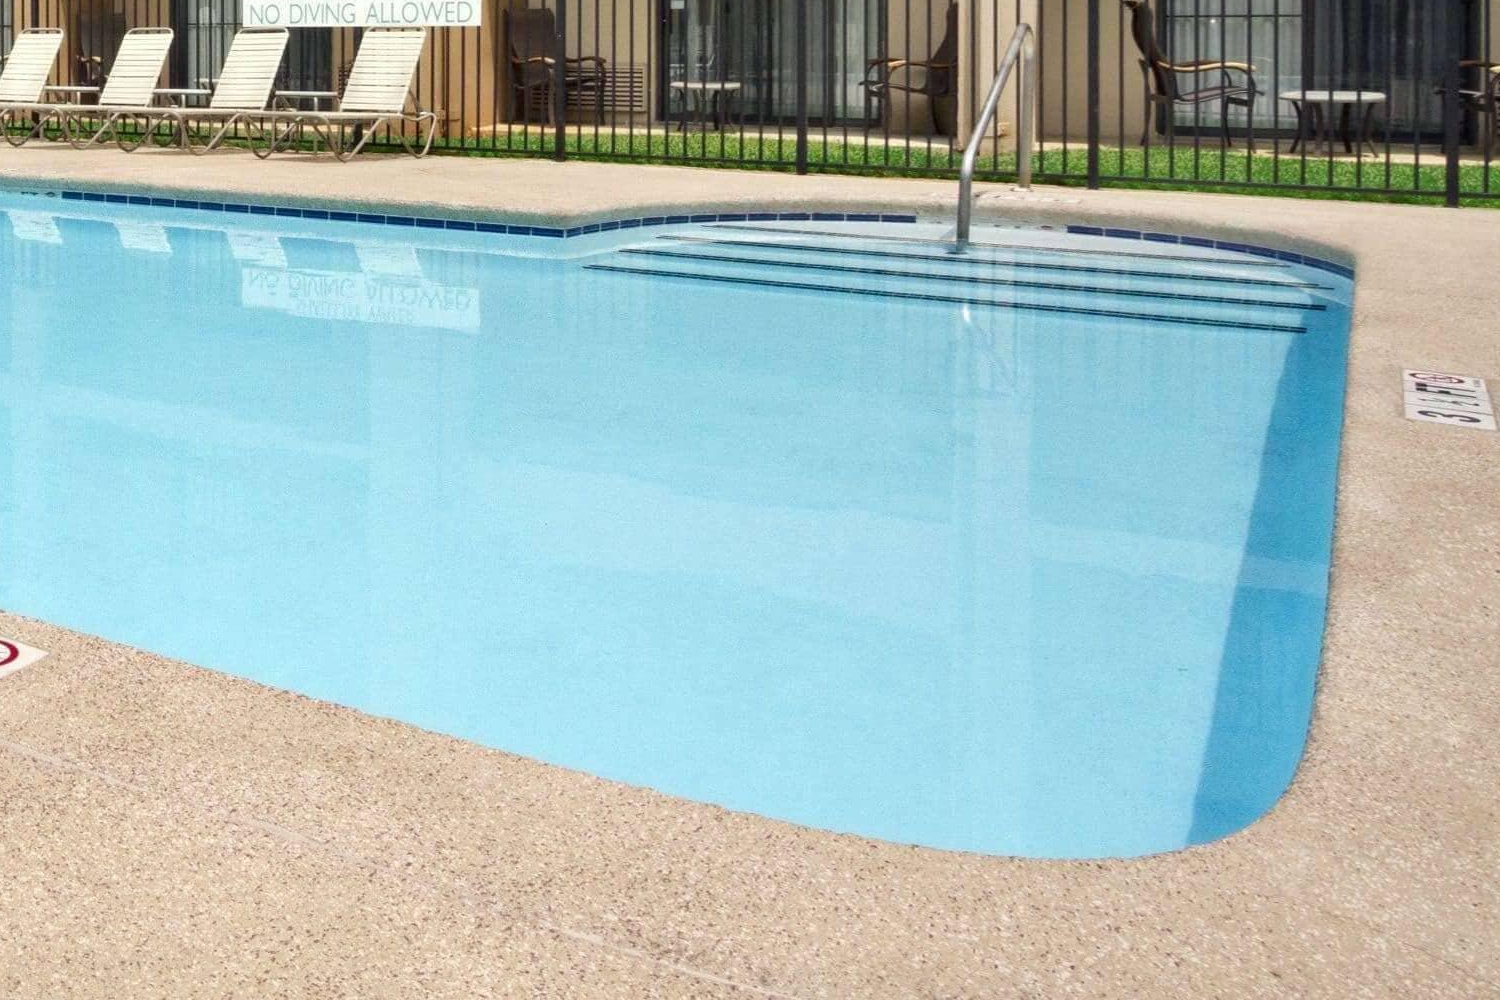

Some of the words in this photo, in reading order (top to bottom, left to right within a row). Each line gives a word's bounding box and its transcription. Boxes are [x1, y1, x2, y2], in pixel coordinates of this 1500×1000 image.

[250, 3, 281, 25] NO
[289, 2, 356, 25] DIVING
[365, 1, 473, 23] ALLOWED
[1415, 382, 1477, 399] FT
